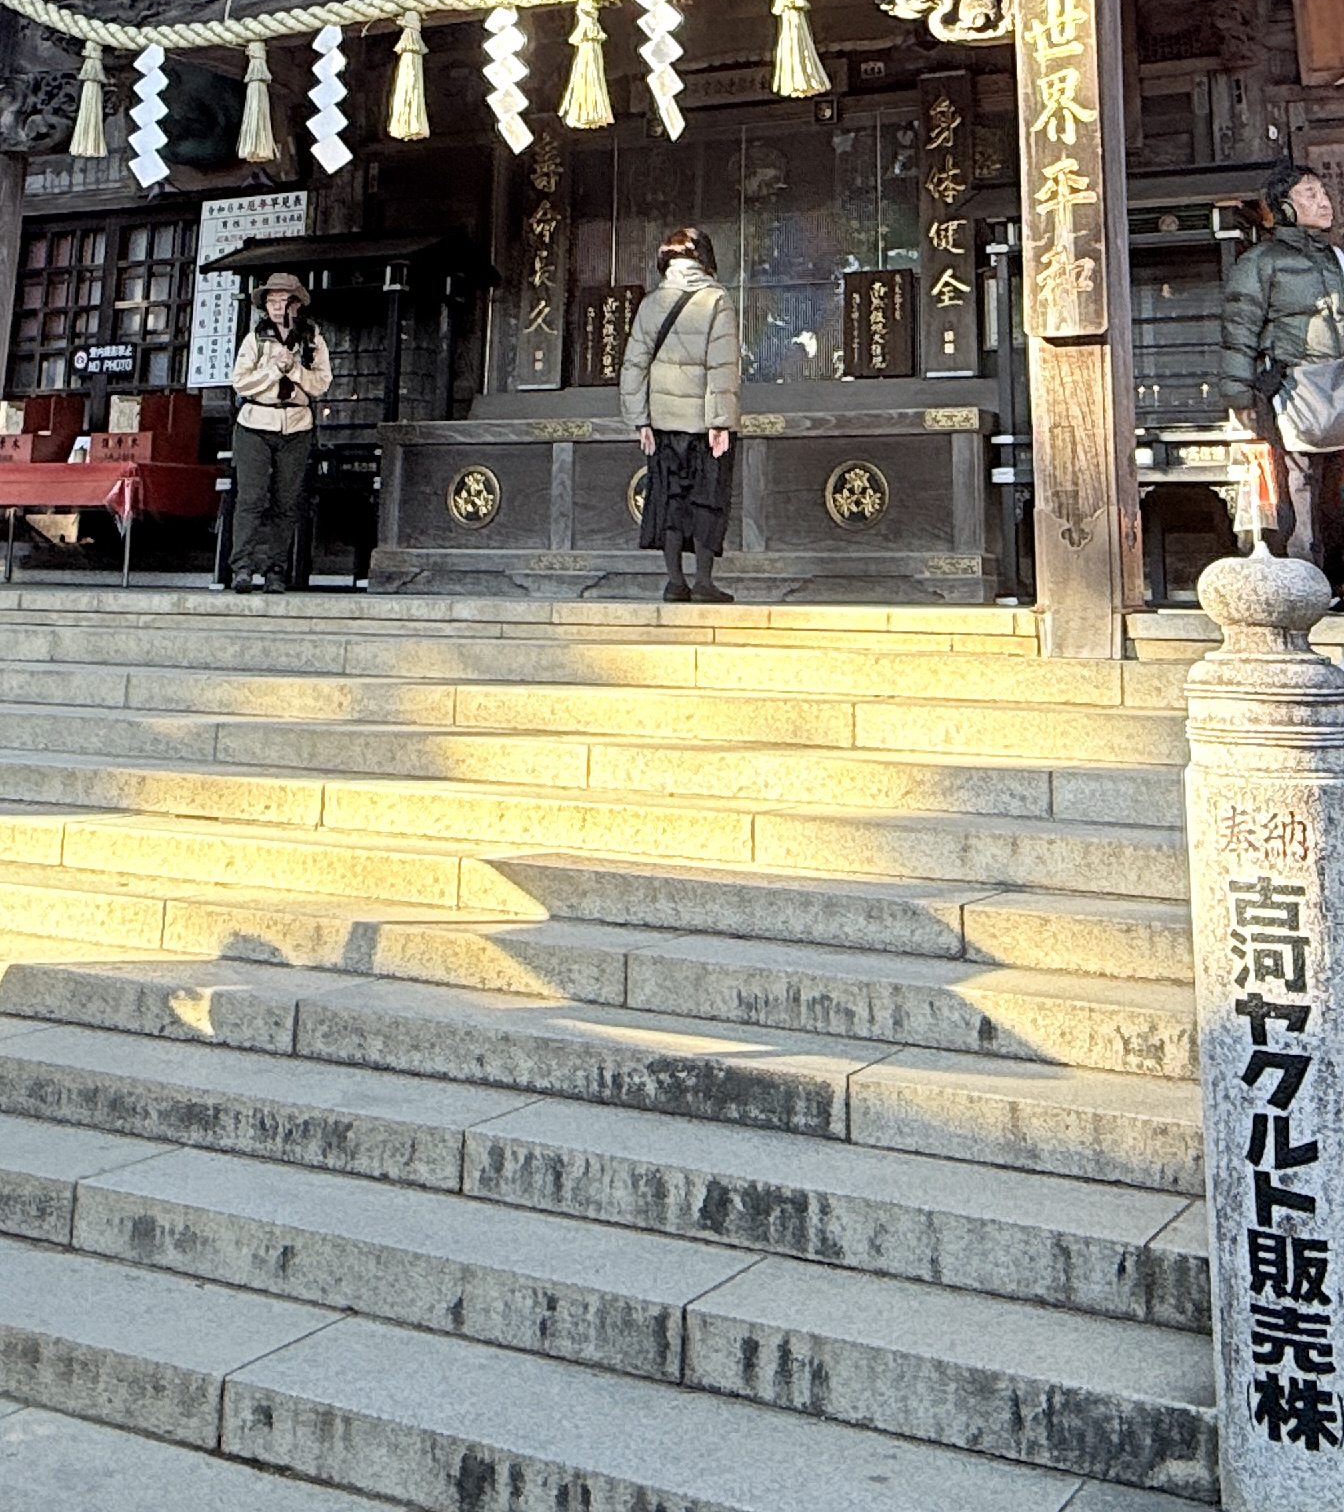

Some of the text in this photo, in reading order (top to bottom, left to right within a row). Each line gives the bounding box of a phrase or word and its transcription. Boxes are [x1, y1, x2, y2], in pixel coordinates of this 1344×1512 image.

[924, 96, 972, 309] 身体健全
[87, 358, 133, 372] NO PHOTO
[1221, 804, 1310, 863] 奉納
